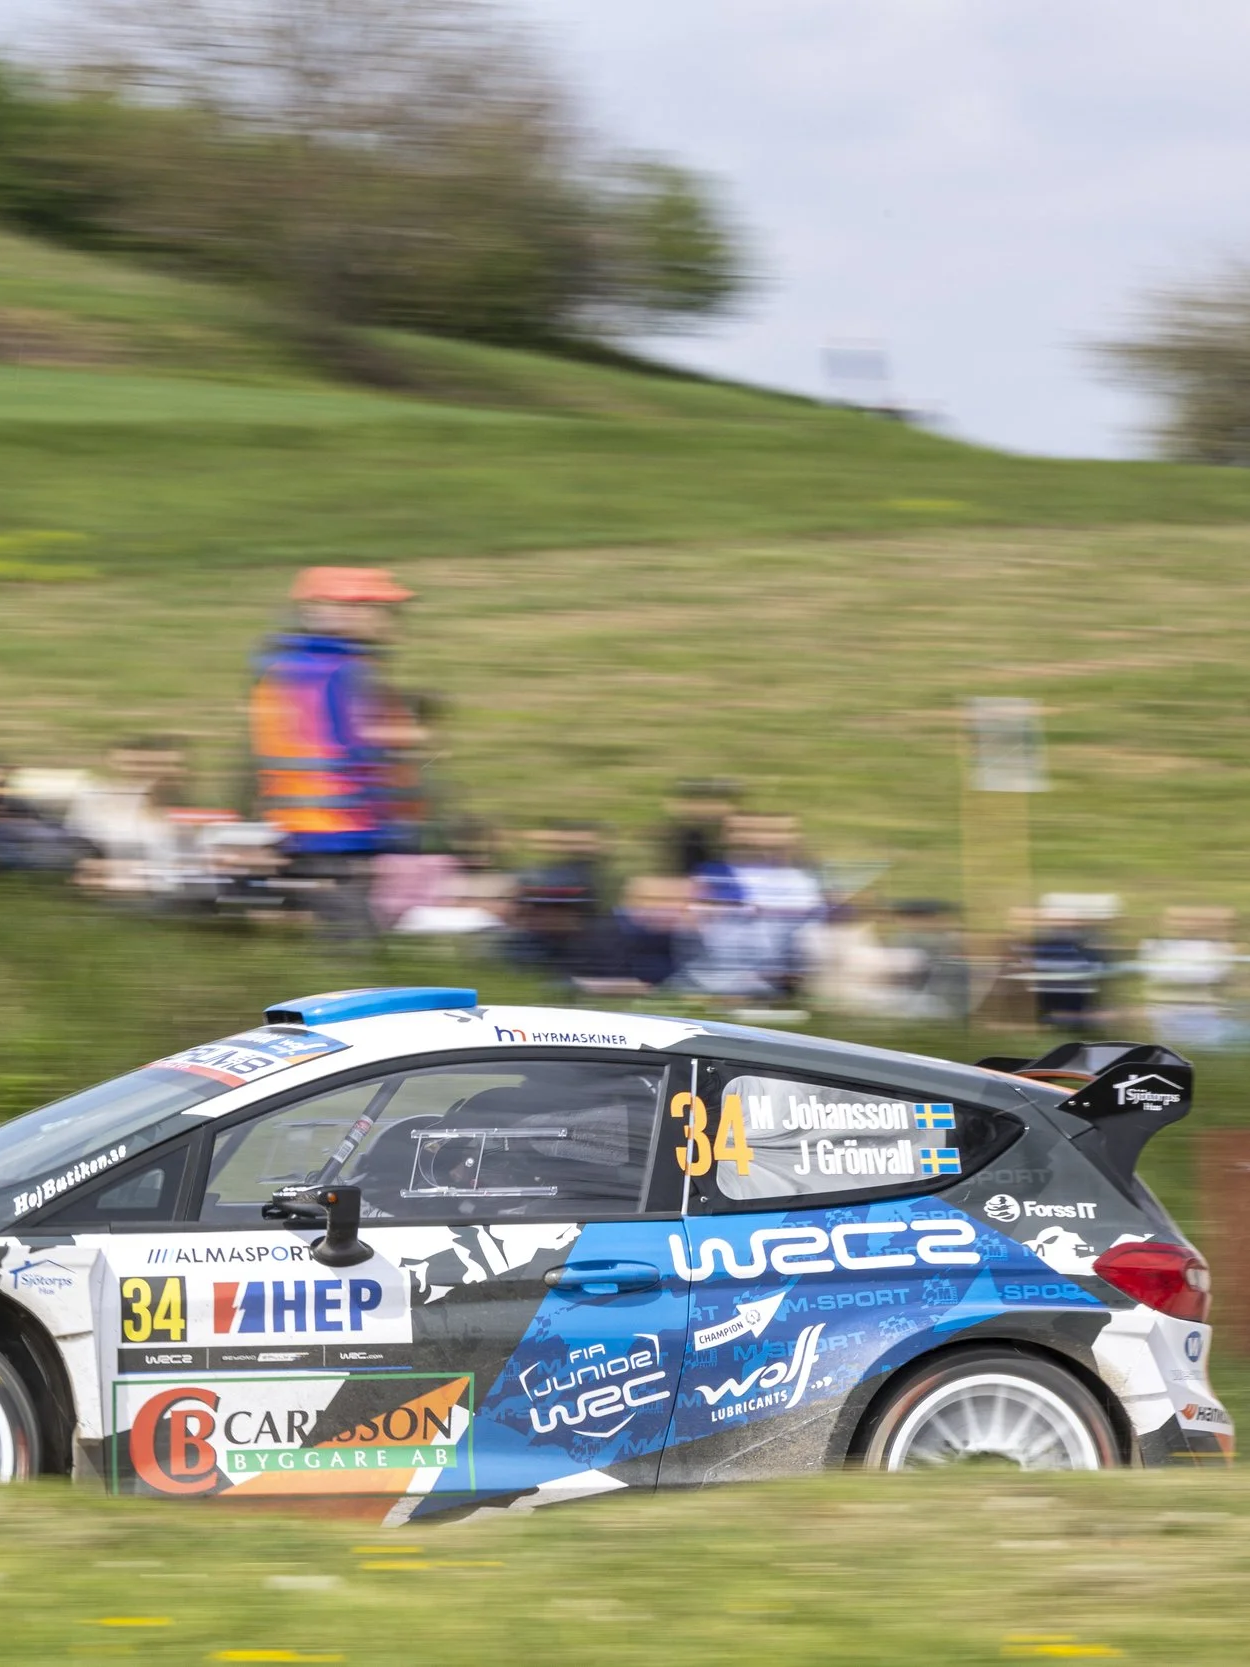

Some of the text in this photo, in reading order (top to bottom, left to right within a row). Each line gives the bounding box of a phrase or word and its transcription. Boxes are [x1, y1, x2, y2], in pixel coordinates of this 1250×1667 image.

[532, 1032, 627, 1045] HYRMASKINER
[671, 1091, 908, 1176] 34 M Johansson
[794, 1139, 914, 1176] J Grönvall
[13, 1144, 127, 1217] HojButiken.se
[1023, 1200, 1097, 1219] Forss IT
[175, 1245, 314, 1264] ALMASPORT
[668, 1218, 981, 1282] WRC2
[121, 1277, 186, 1343] 34
[784, 1288, 910, 1313] M-SPORT
[698, 1320, 744, 1345] CHAMPION
[145, 1354, 193, 1364] WRC2
[340, 1351, 384, 1360] WRC.com
[569, 1343, 606, 1364] FIA
[533, 1350, 653, 1398] JUNIOR
[529, 1370, 671, 1434] WRC
[711, 1390, 788, 1422] LUBRICANTS
[224, 1405, 453, 1445] CARSON
[234, 1449, 448, 1471] BYGGARE AB
